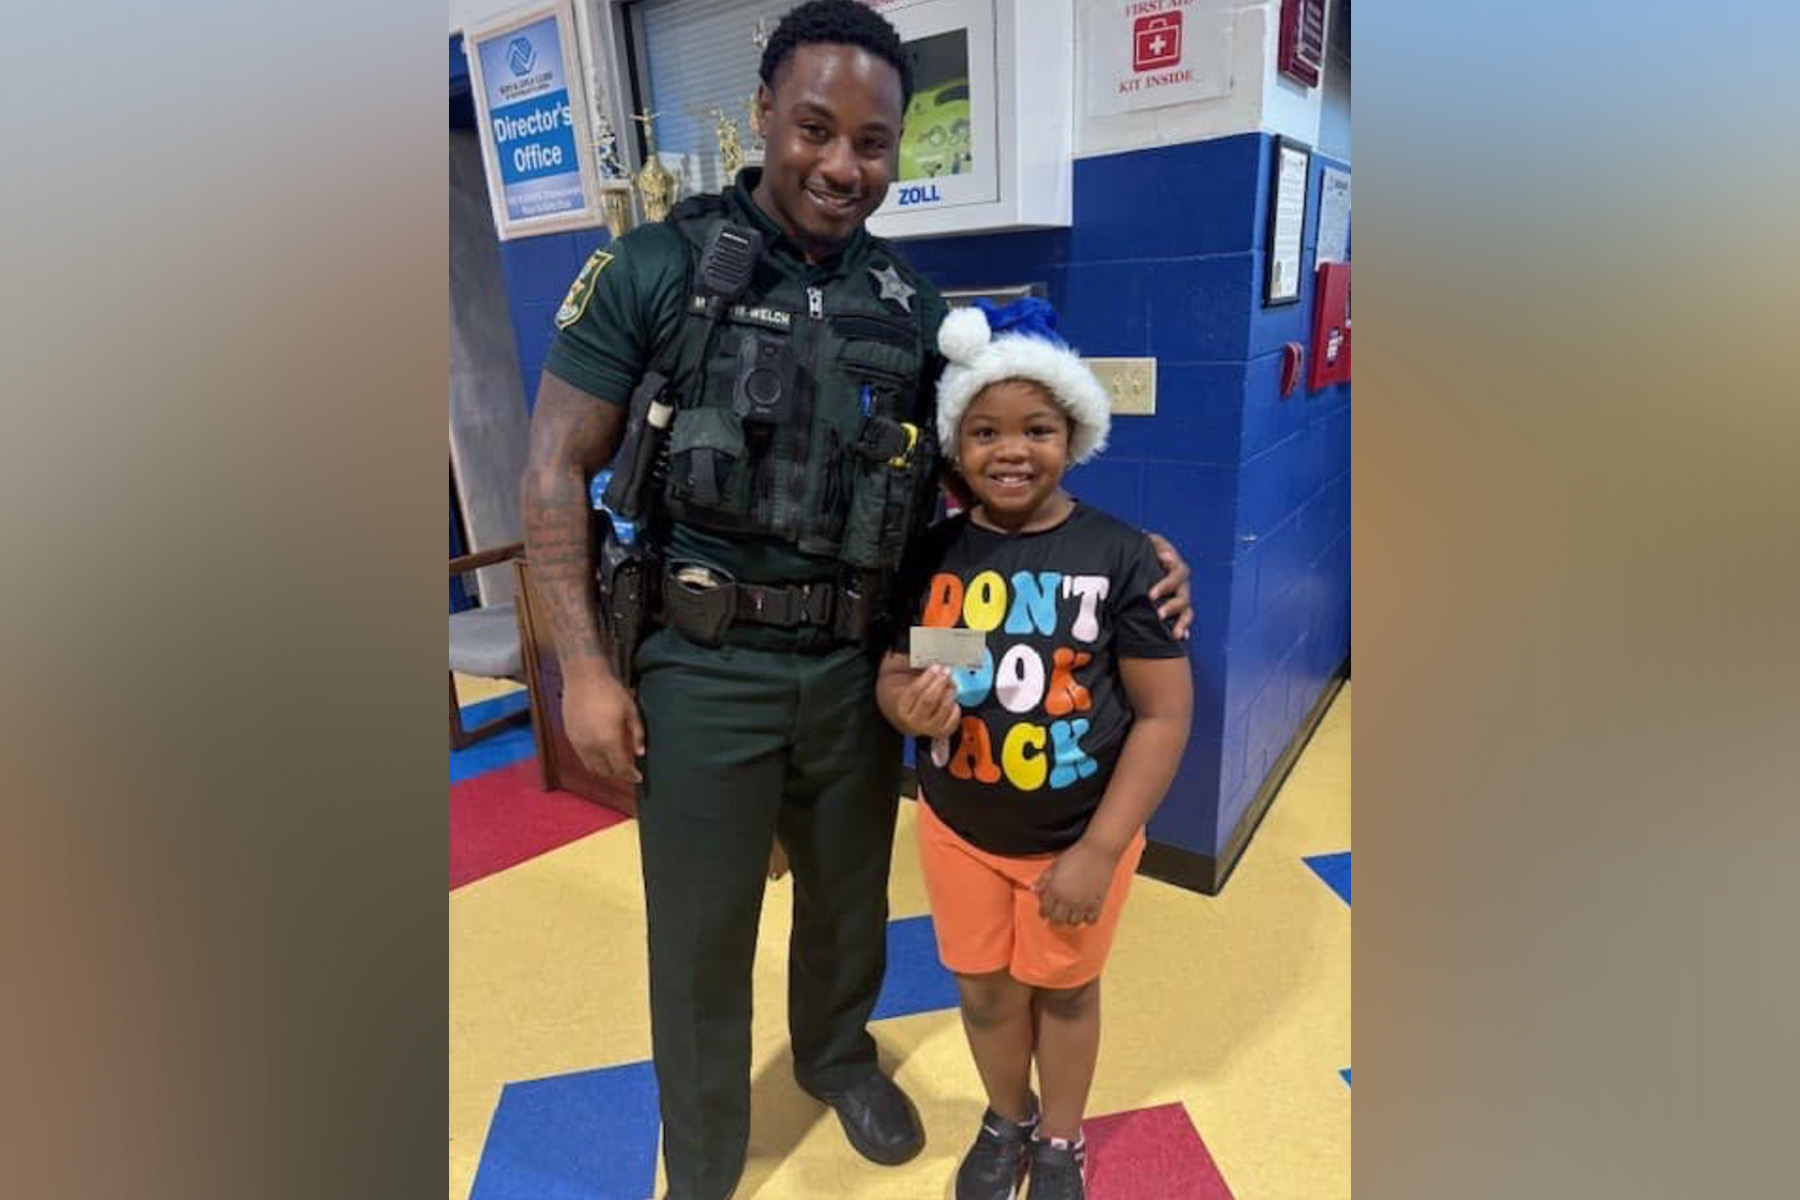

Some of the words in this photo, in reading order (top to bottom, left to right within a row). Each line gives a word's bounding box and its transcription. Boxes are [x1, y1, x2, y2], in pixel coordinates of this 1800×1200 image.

[1119, 79, 1140, 94] KIT
[1145, 70, 1194, 89] INSIDE
[493, 101, 571, 143] Director's
[514, 144, 562, 172] Office
[898, 184, 941, 205] ZOLL
[922, 570, 1110, 643] DON'T
[952, 643, 1093, 716] OOK
[931, 715, 1098, 790] ACK
